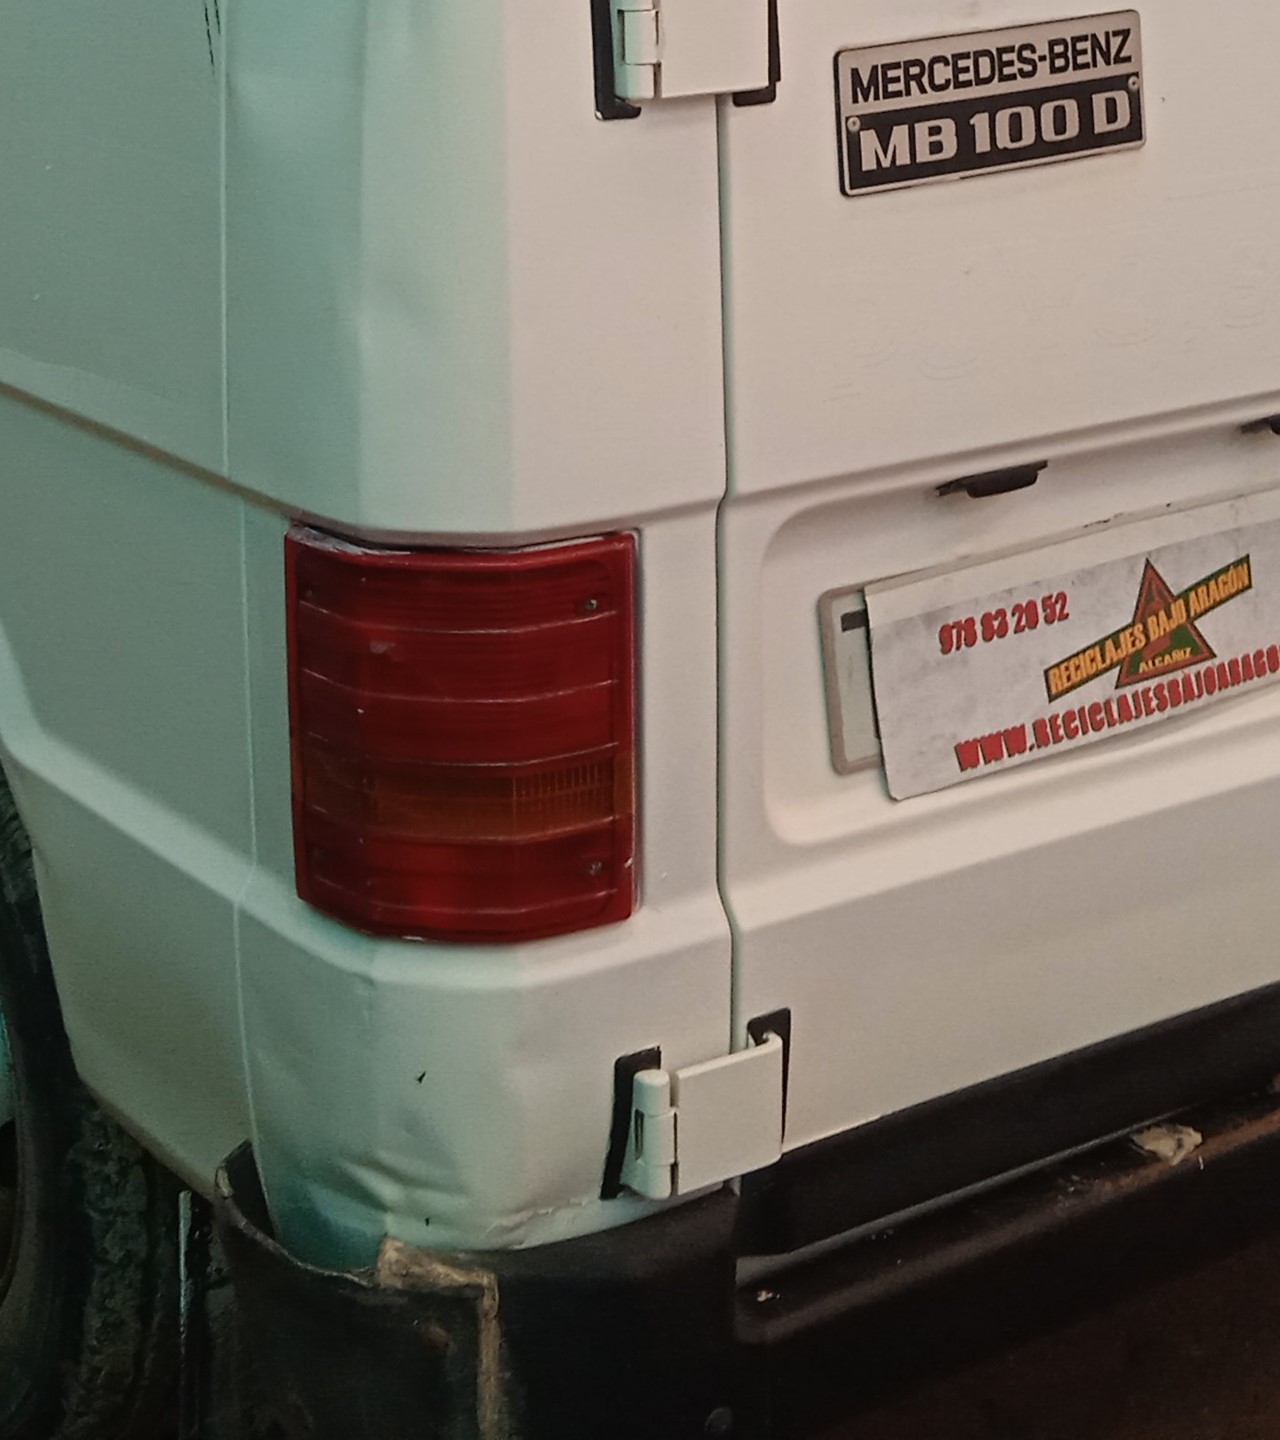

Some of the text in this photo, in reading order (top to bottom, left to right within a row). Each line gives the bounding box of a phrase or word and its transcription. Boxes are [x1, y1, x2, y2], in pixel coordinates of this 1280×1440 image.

[850, 27, 1132, 104] MERCEDES-BENZ
[859, 89, 1131, 172] MB 100 D
[939, 616, 978, 655] 978
[1012, 599, 1039, 635] 20
[1042, 591, 1070, 625] 52
[1048, 623, 1146, 694] RECICLAJES
[1147, 598, 1187, 641] BAJO
